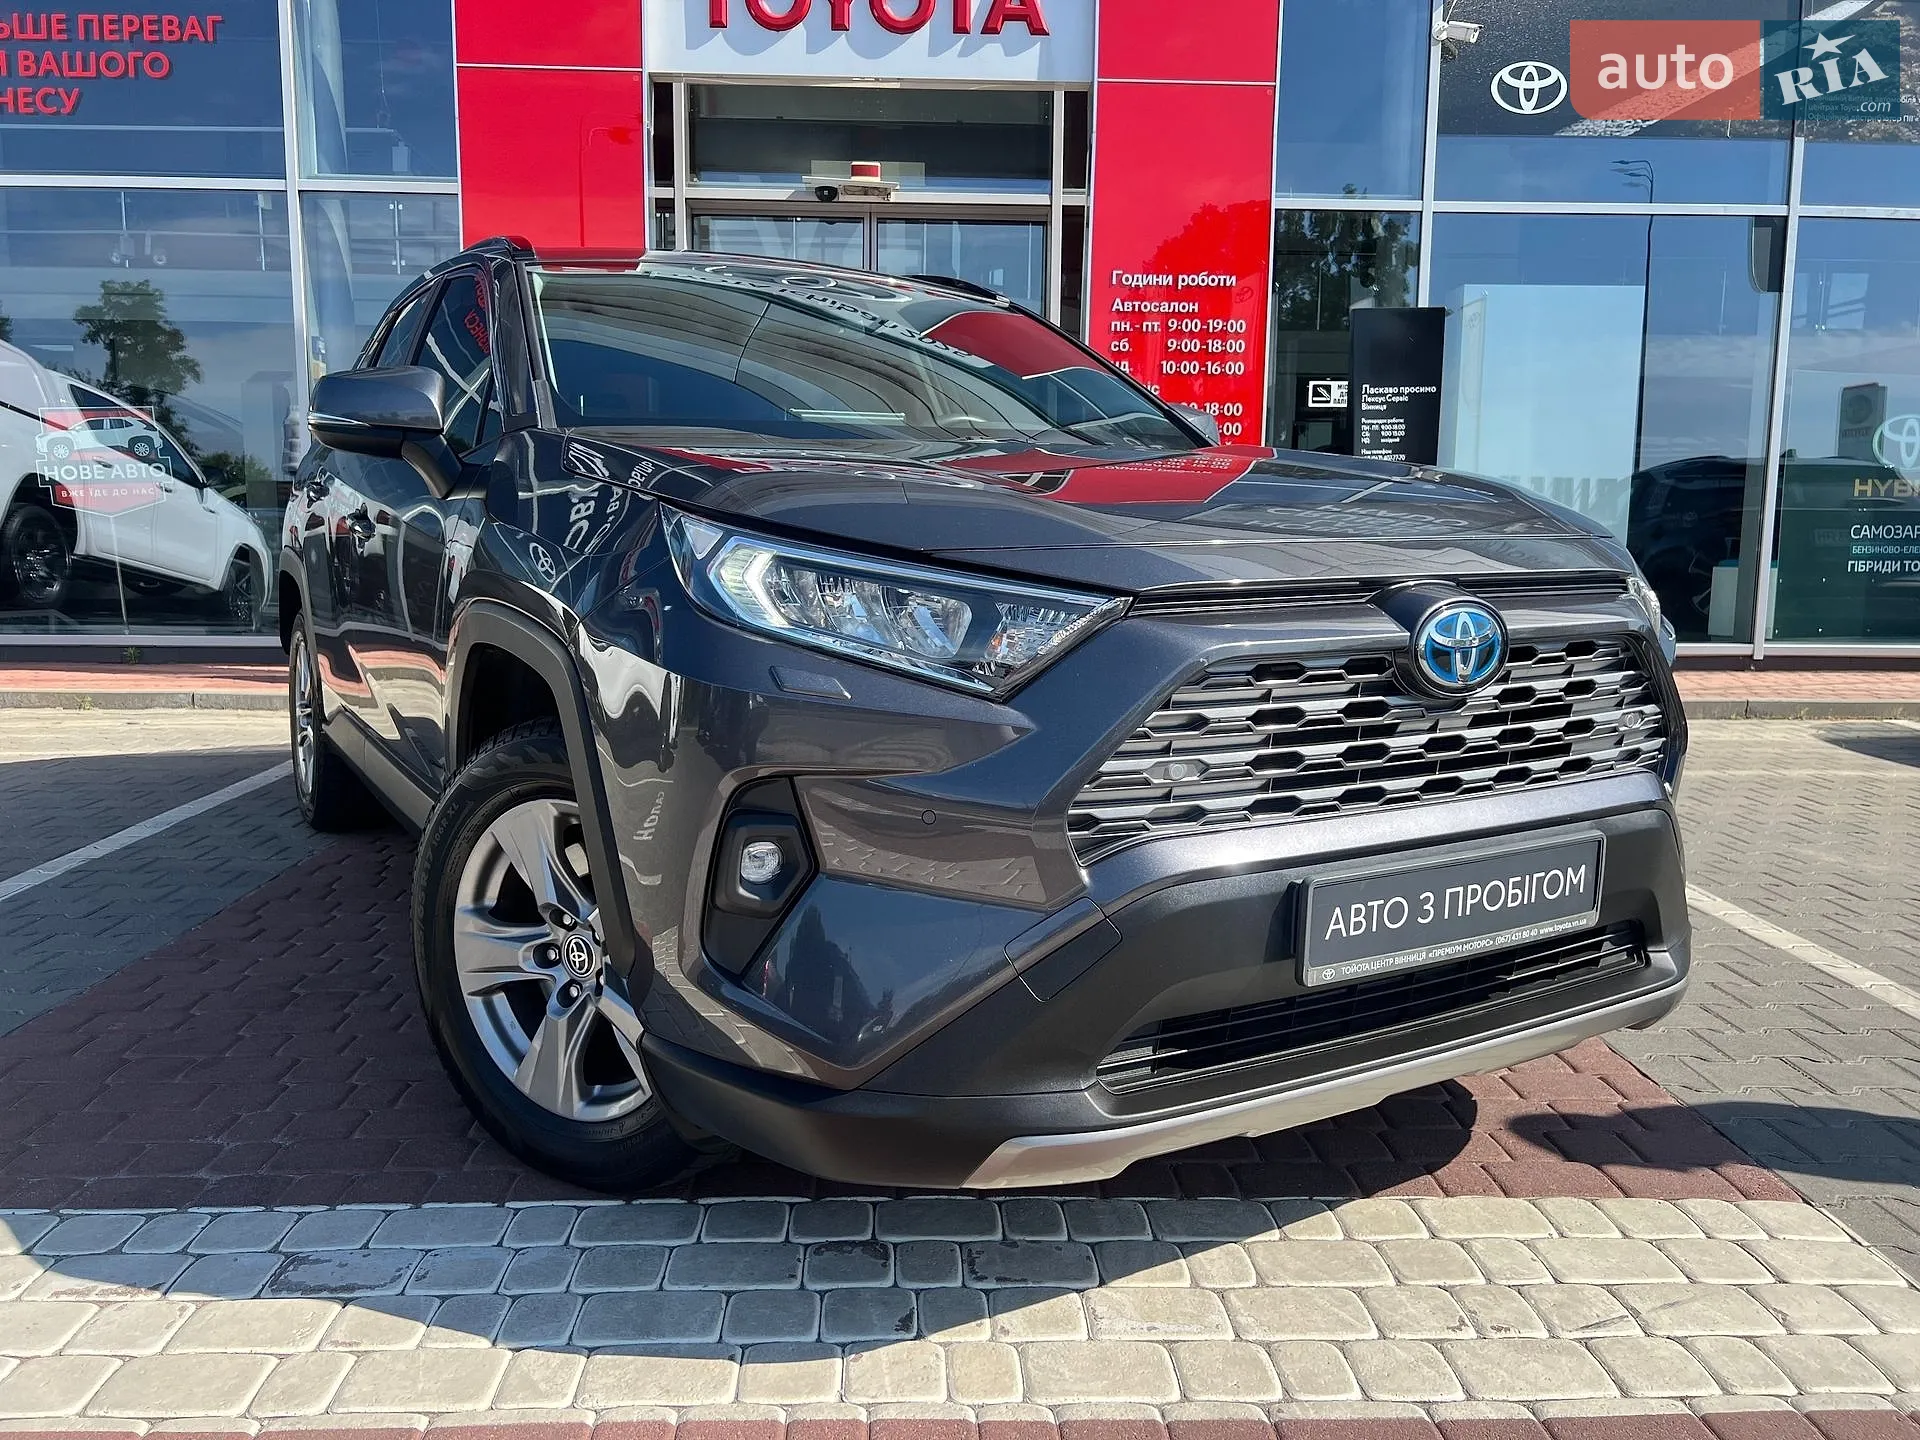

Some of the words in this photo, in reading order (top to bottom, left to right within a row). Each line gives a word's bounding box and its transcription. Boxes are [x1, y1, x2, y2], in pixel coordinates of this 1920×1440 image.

[78, 14, 223, 41] ПЕРЕВАГ
[18, 50, 170, 77] ВАШОГО
[1111, 270, 1173, 288] Години
[1178, 271, 1237, 290] роботи
[1111, 298, 1199, 313] Автосалон
[1167, 318, 1247, 333] 9:00-19:00
[1111, 338, 1133, 352] сб.
[1167, 338, 1246, 353] 9:00-18:00
[1161, 360, 1245, 375] 10:00-16:00
[1361, 383, 1398, 395] Ласкаво
[1400, 384, 1437, 395] просимо
[42, 465, 104, 481] НОВЕ
[111, 462, 166, 479] АВТО
[61, 489, 85, 498] ВЖЕ
[132, 487, 156, 496] НАС
[1847, 560, 1901, 574] ГІБРИДИ
[1325, 896, 1409, 941] АВТО
[1444, 864, 1586, 919] ПРОБІГОМ
[1341, 963, 1370, 975] ТОЙОТА
[1371, 958, 1393, 970] ЦЕНТР
[1394, 952, 1426, 965] ВІННИЦЯ
[1530, 928, 1538, 936] 40
